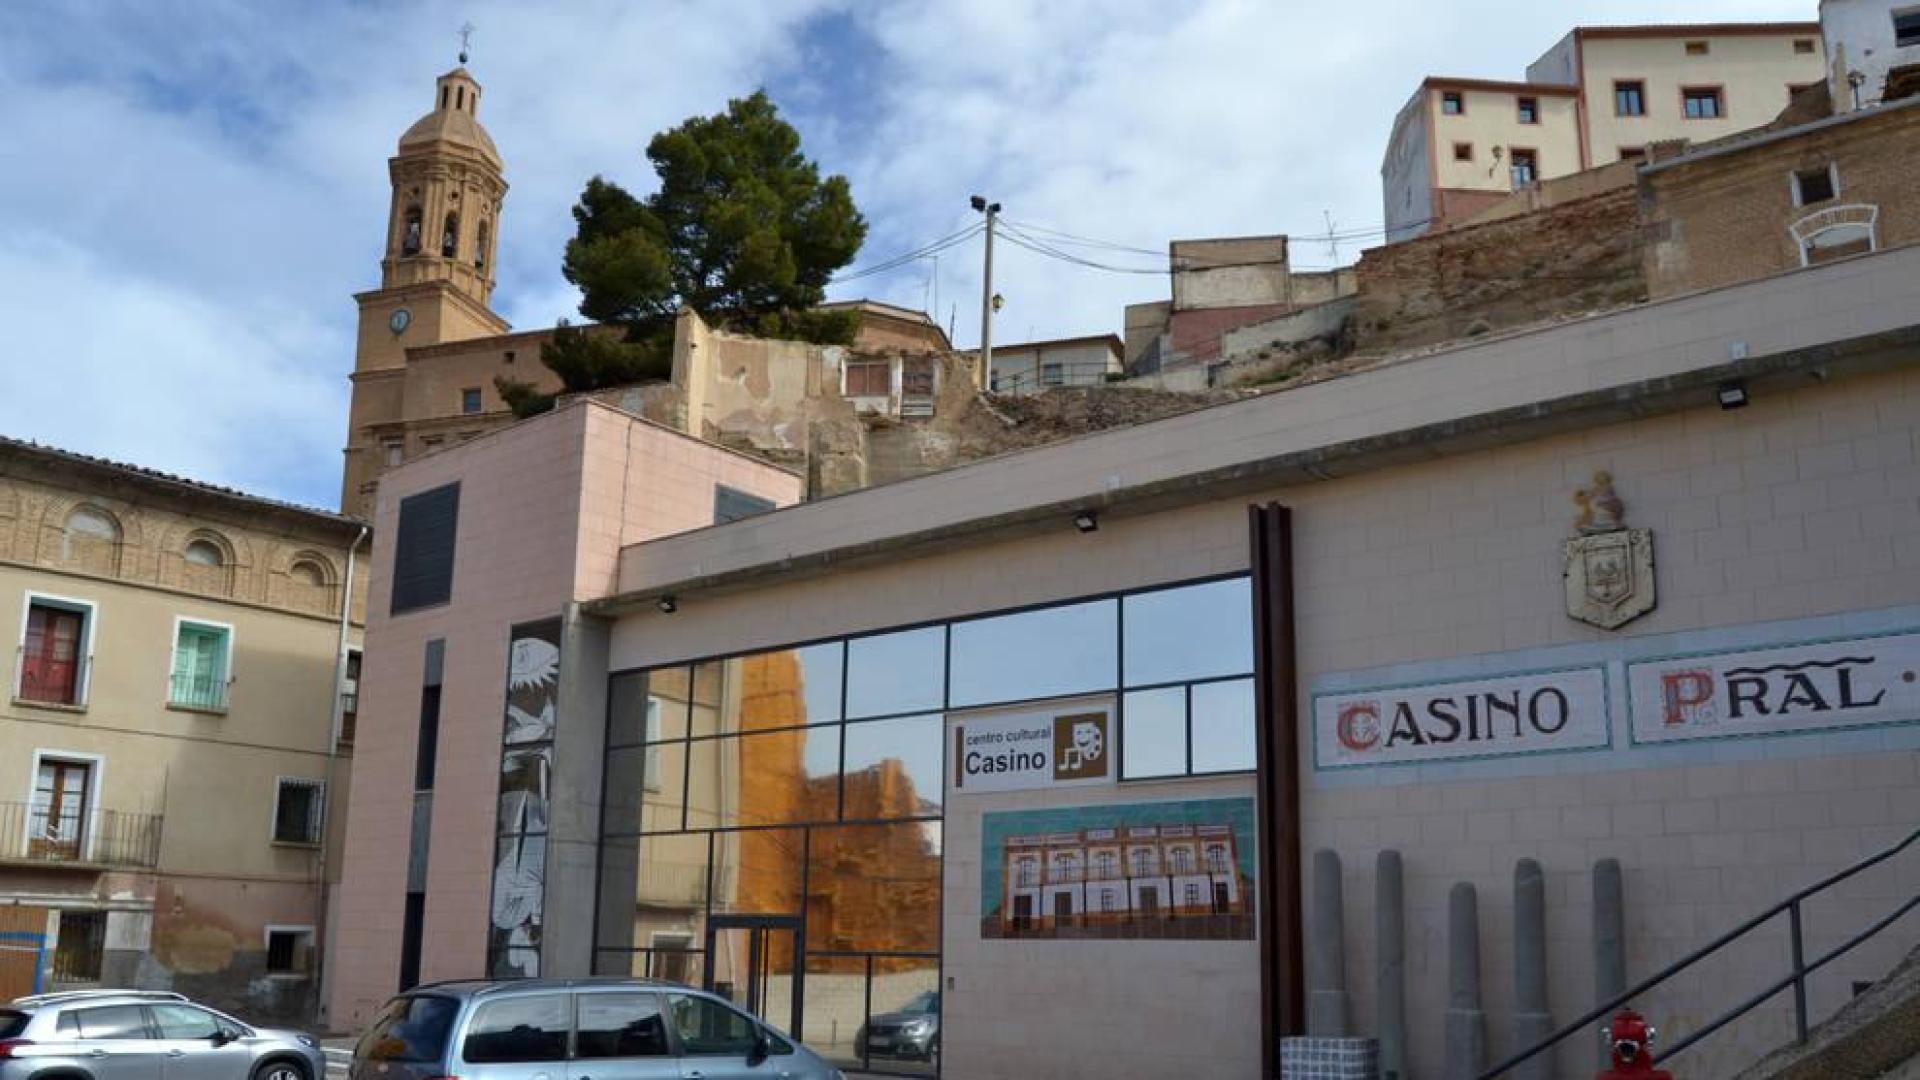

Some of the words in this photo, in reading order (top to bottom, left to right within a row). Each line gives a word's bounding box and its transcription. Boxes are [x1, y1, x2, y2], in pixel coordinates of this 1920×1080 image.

[1336, 687, 1568, 752] CASINO
[1662, 667, 1886, 726] PRAL
[967, 732, 1003, 745] centro
[1006, 726, 1051, 742] cultural
[966, 748, 1046, 775] Casino
